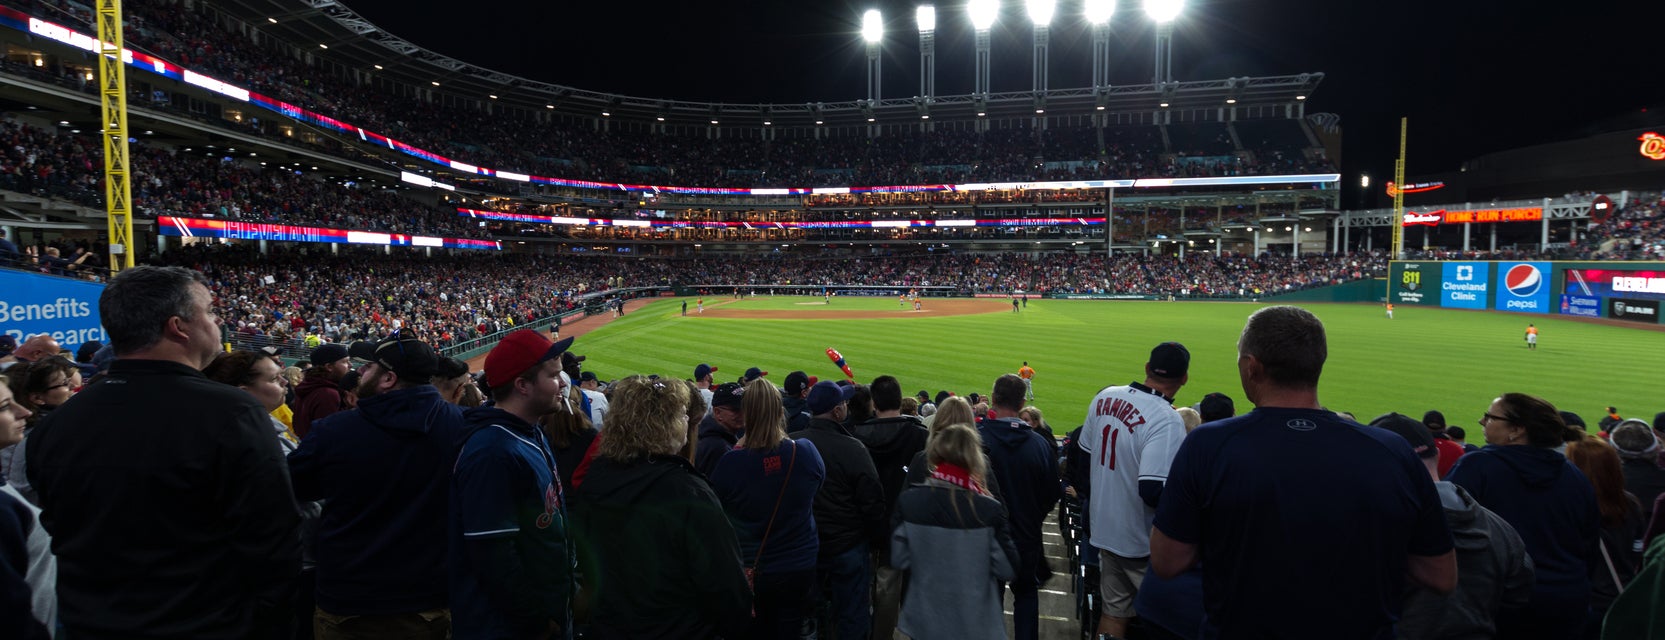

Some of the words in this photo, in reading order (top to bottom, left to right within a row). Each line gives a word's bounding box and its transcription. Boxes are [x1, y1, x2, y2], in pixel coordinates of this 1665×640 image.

[1446, 211, 1474, 223] HOME
[1477, 209, 1500, 222] RUN
[1502, 207, 1542, 221] PORCH
[1402, 271, 1420, 284] 811
[1442, 282, 1487, 292] Cleveland
[1450, 292, 1476, 301] Clinic
[0, 298, 91, 323] Benefits
[1506, 299, 1538, 310] pepsi
[1625, 305, 1655, 315] RAM
[1095, 397, 1146, 435] RAMIREZ
[1101, 424, 1119, 471] 11
